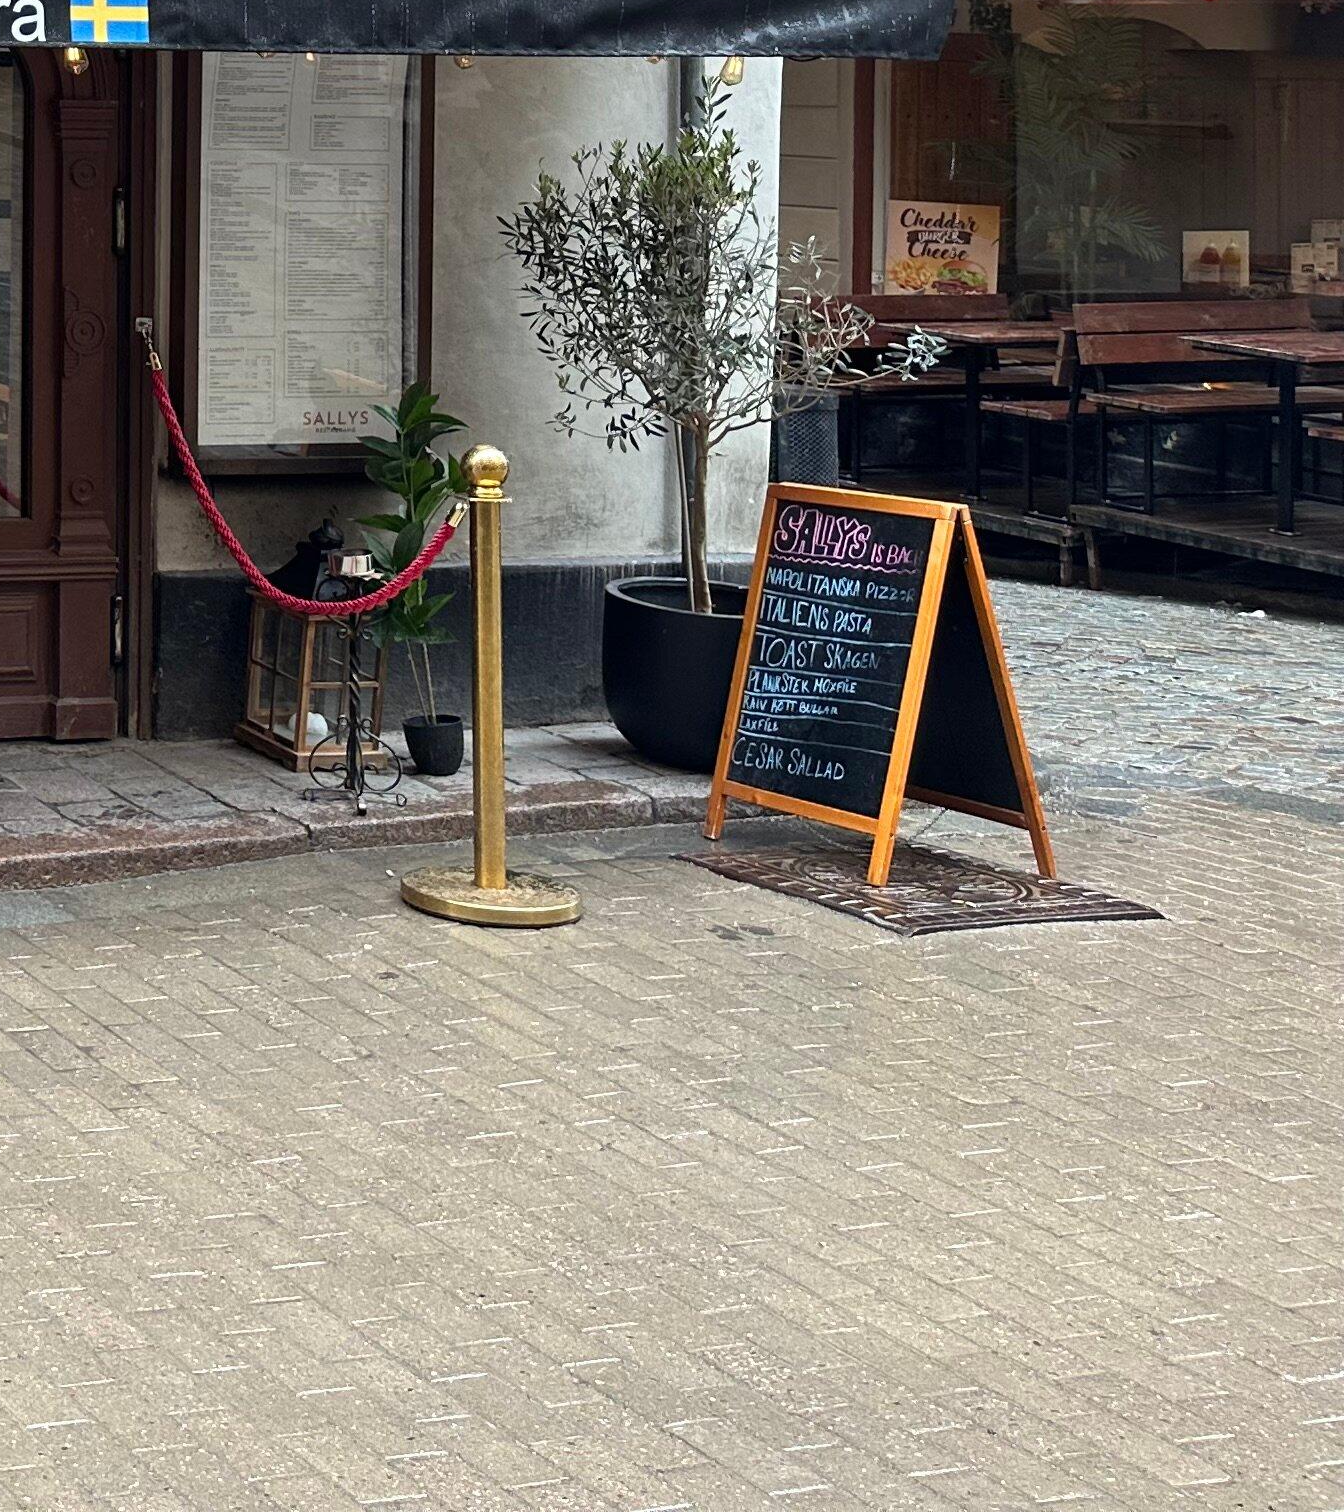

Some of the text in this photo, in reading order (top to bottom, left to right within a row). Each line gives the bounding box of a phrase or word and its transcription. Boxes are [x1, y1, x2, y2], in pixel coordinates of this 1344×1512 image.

[900, 208, 979, 232] Cheddar
[908, 241, 970, 261] Cheese
[302, 410, 370, 426] SALLYS
[774, 504, 872, 560] SALLYS
[870, 542, 886, 564] IS
[765, 566, 861, 598] NAPOLITANSKA
[759, 593, 873, 636] ITALIENS PASTA
[755, 631, 880, 671] TOAST SKAGEN
[731, 736, 846, 781] CESAR SALLAD
